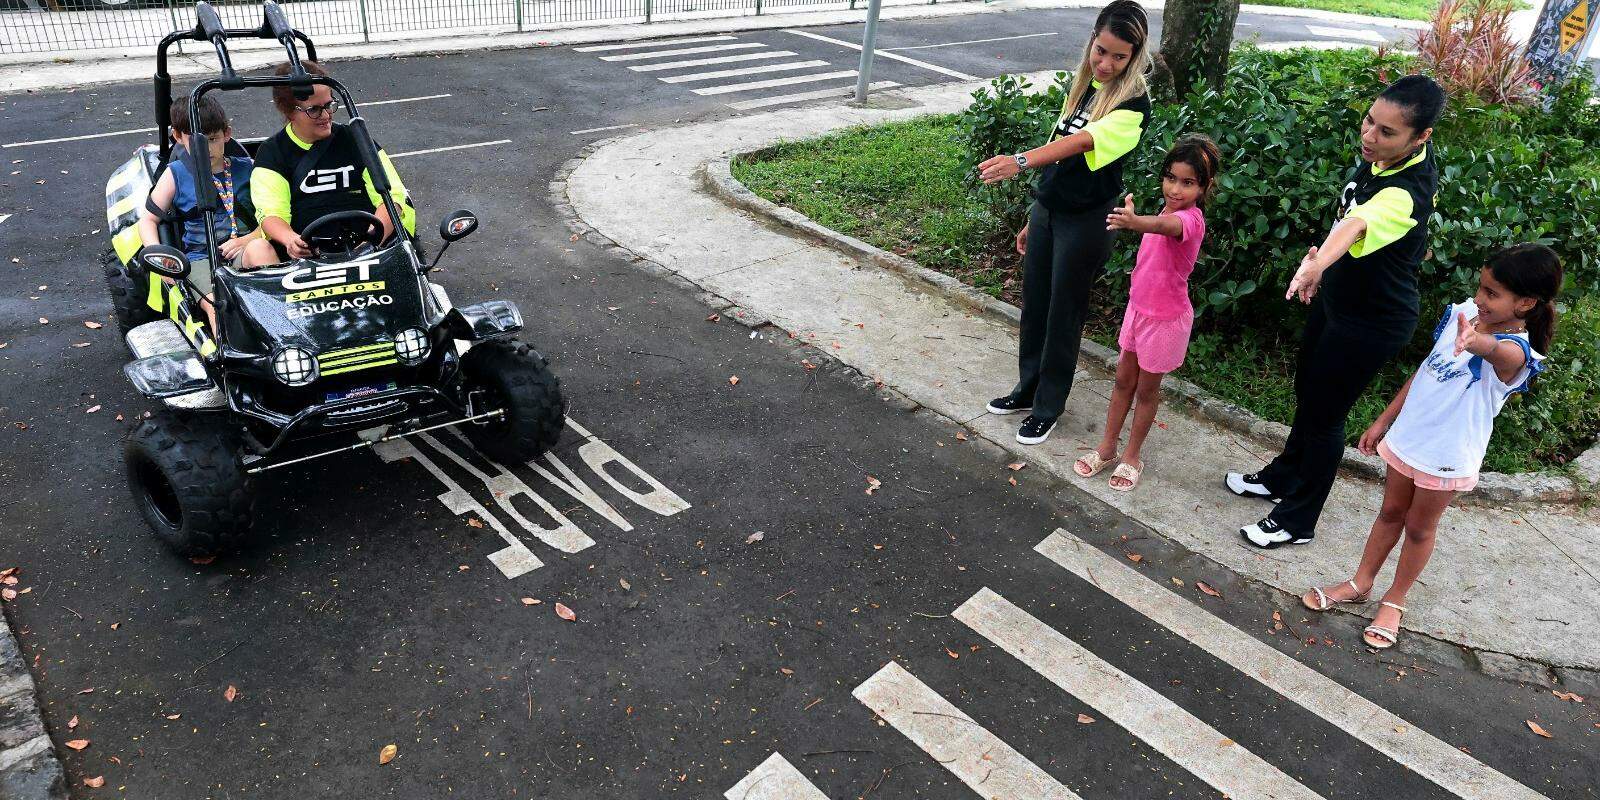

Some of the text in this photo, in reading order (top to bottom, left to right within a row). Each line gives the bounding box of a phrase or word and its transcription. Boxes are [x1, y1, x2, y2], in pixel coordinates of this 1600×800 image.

[300, 165, 355, 194] CET
[281, 258, 380, 290] CET
[292, 282, 382, 301] SANTOS
[286, 294, 393, 320] EDUCAÇÃO
